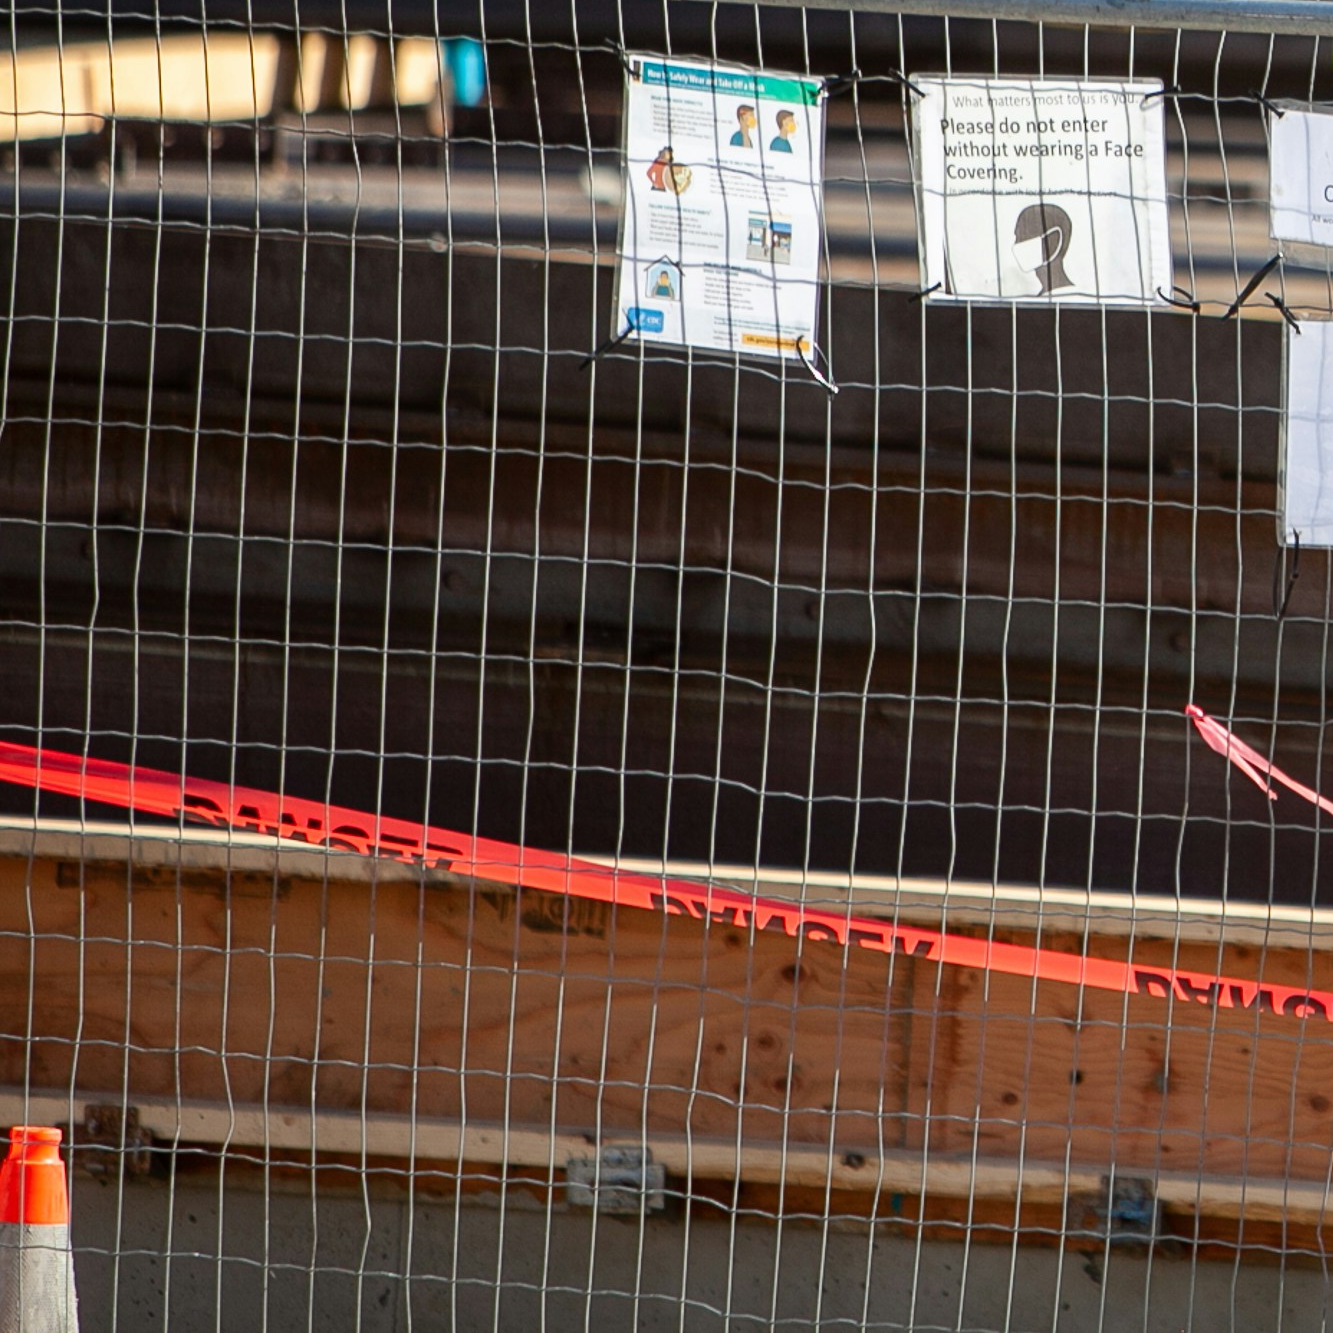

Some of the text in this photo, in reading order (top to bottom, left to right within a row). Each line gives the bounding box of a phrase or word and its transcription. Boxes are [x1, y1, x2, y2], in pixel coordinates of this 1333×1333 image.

[953, 96, 983, 108] What
[1034, 94, 1063, 106] most
[1067, 94, 1080, 105] to
[1083, 95, 1096, 105] us
[941, 117, 1108, 135] Please do not enter
[944, 140, 1143, 160] without wearing a Face
[946, 163, 1023, 183] Covering.
